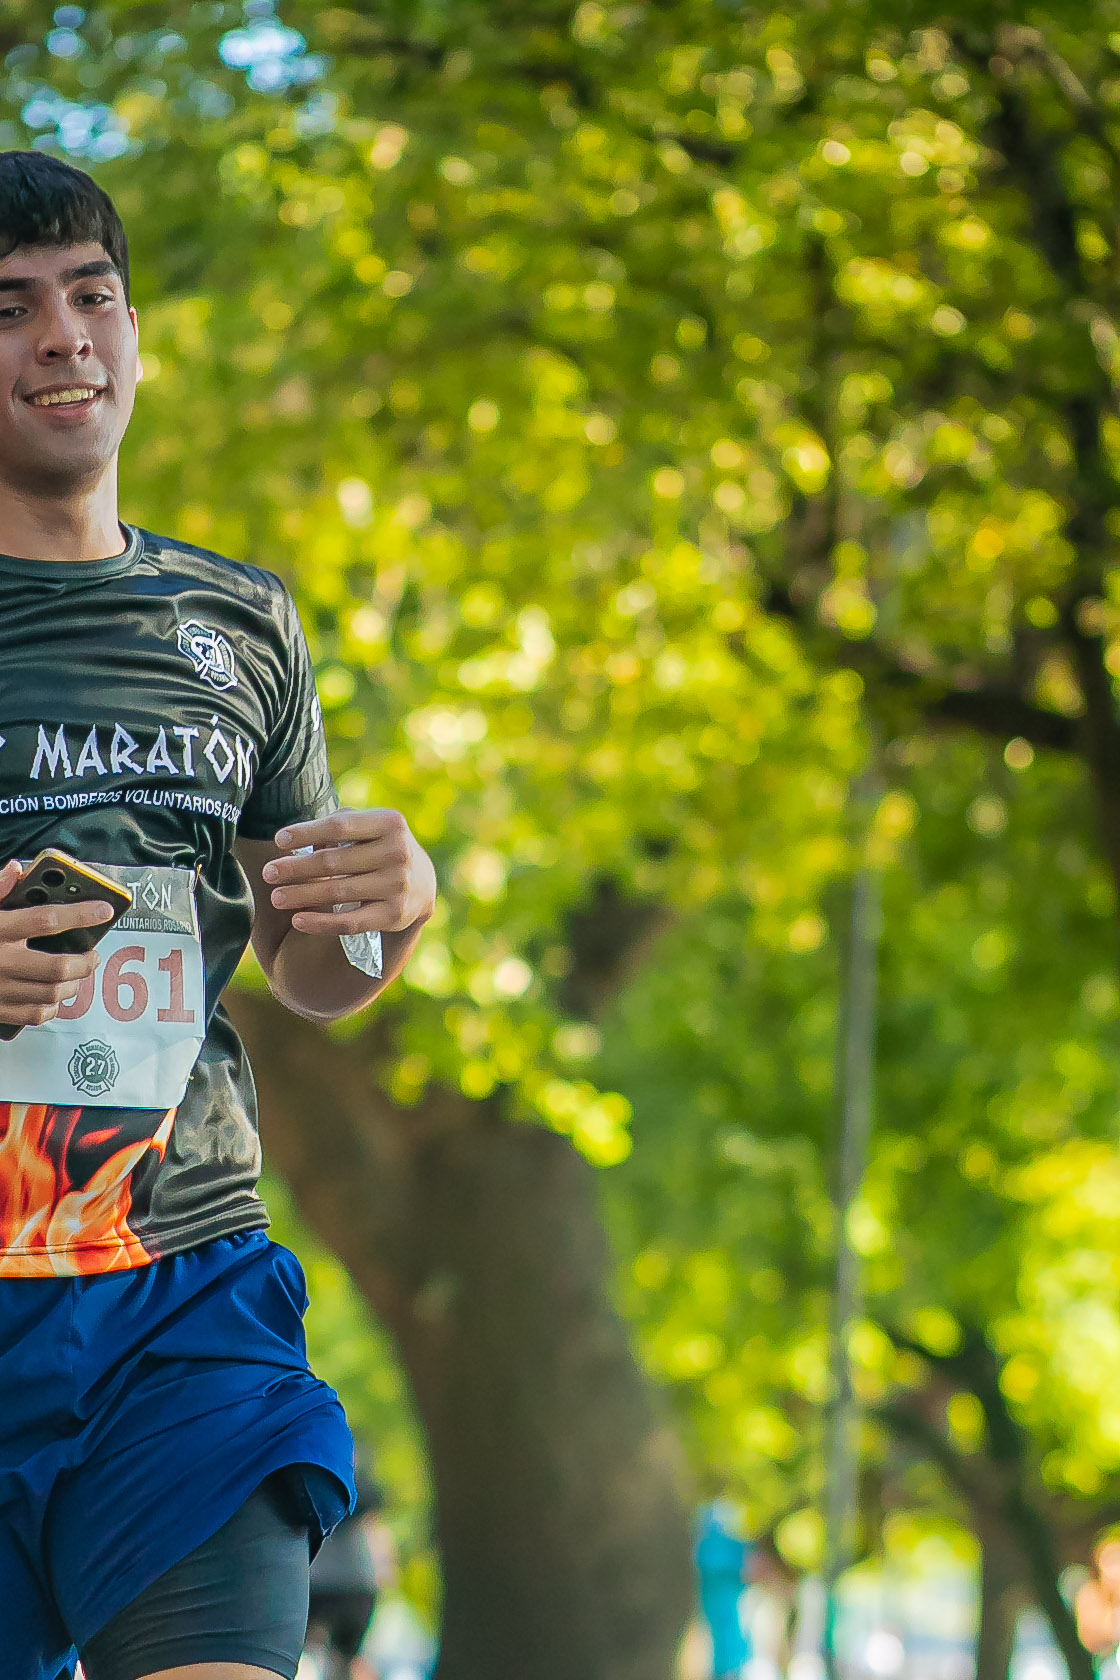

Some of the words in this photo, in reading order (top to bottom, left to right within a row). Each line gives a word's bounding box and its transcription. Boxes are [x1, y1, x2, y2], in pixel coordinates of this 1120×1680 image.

[29, 713, 255, 790] MARATÓN
[42, 790, 123, 811] BOMBEROS
[124, 788, 222, 817] VOLUNTARIOS
[163, 919, 192, 933] ROSARIO
[85, 1057, 106, 1076] 27
